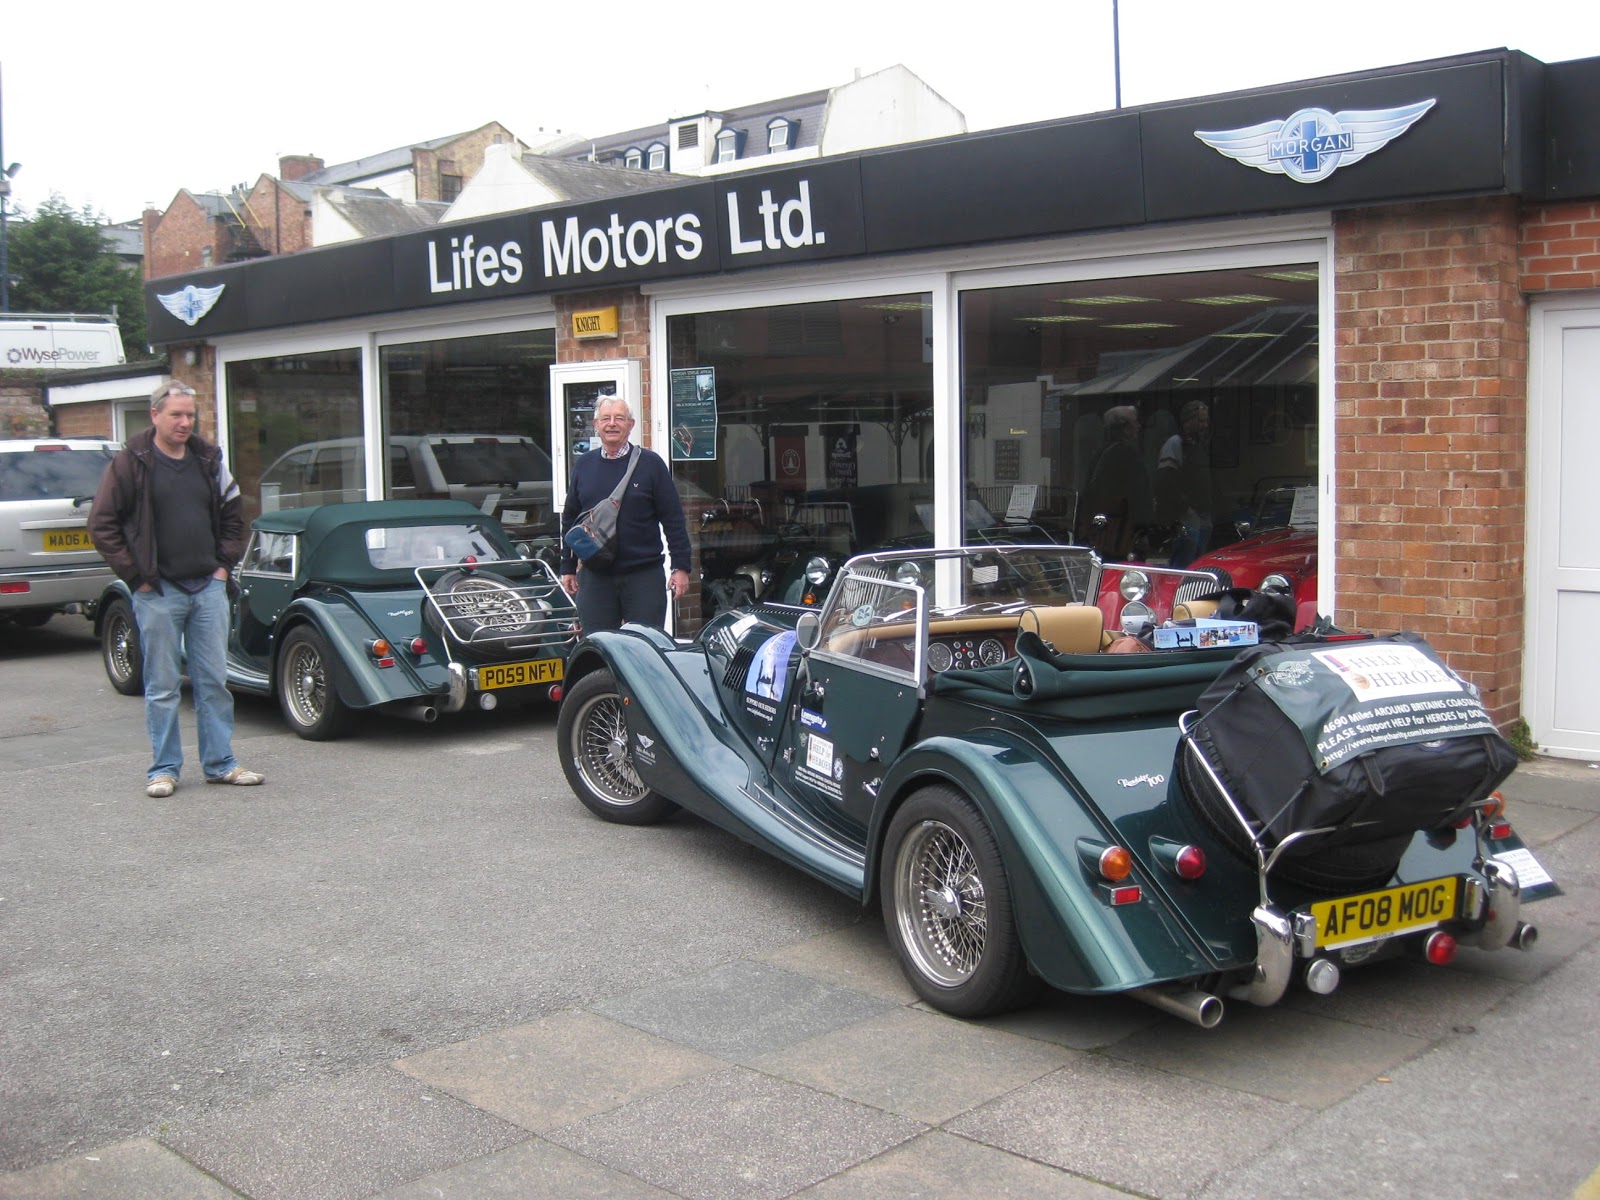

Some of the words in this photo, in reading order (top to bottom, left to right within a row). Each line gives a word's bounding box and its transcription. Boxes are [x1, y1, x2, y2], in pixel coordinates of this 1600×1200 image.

[1271, 133, 1350, 157] MORGAN
[428, 235, 523, 293] Lifes
[541, 213, 703, 278] Motors
[727, 180, 826, 255] Ltd.
[575, 316, 600, 332] KNIGHT
[22, 348, 100, 363] WysePower
[49, 534, 80, 547] MA06
[83, 533, 94, 547] A
[1349, 655, 1402, 669] HELP
[485, 665, 525, 687] PO59
[528, 662, 557, 681] NFV
[1368, 669, 1452, 688] HEROES
[1323, 716, 1348, 734] 4690
[1348, 710, 1374, 723] Miles
[1374, 705, 1410, 717] AROUND
[1410, 700, 1447, 712] BRITAINS
[1317, 726, 1357, 753] PLEASE
[1356, 719, 1392, 734] Support
[1390, 716, 1411, 728] HELP
[1412, 715, 1425, 725] for
[1424, 711, 1457, 724] HEROES
[1457, 710, 1468, 721] by
[1323, 895, 1392, 938] AF08
[1399, 884, 1446, 923] MOG
